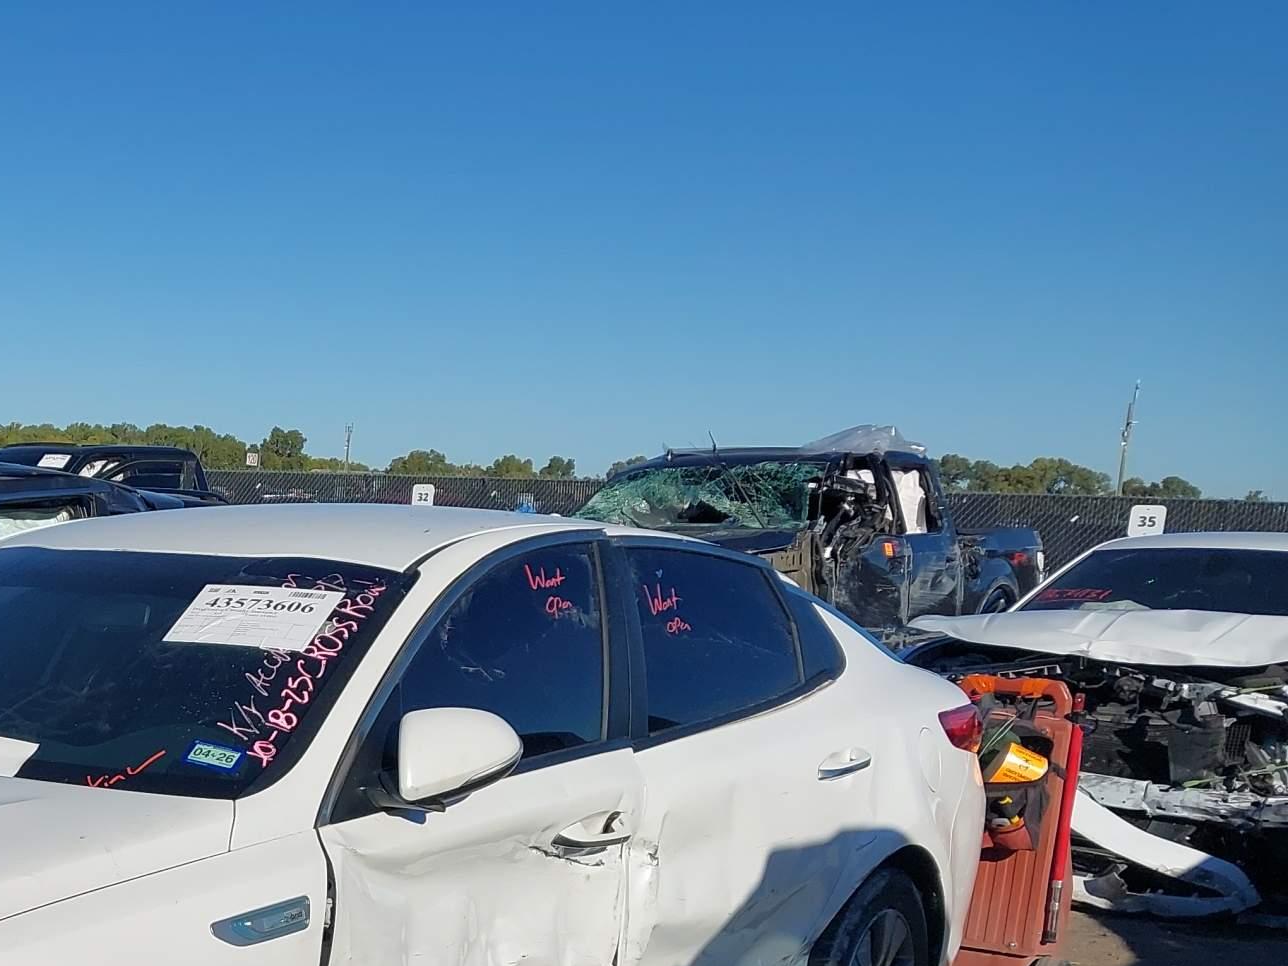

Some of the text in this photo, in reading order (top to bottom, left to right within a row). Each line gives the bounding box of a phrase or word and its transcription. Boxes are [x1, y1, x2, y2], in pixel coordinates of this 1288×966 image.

[416, 492, 429, 502] 32
[1137, 516, 1157, 528] 35
[205, 596, 318, 614] 43573606
